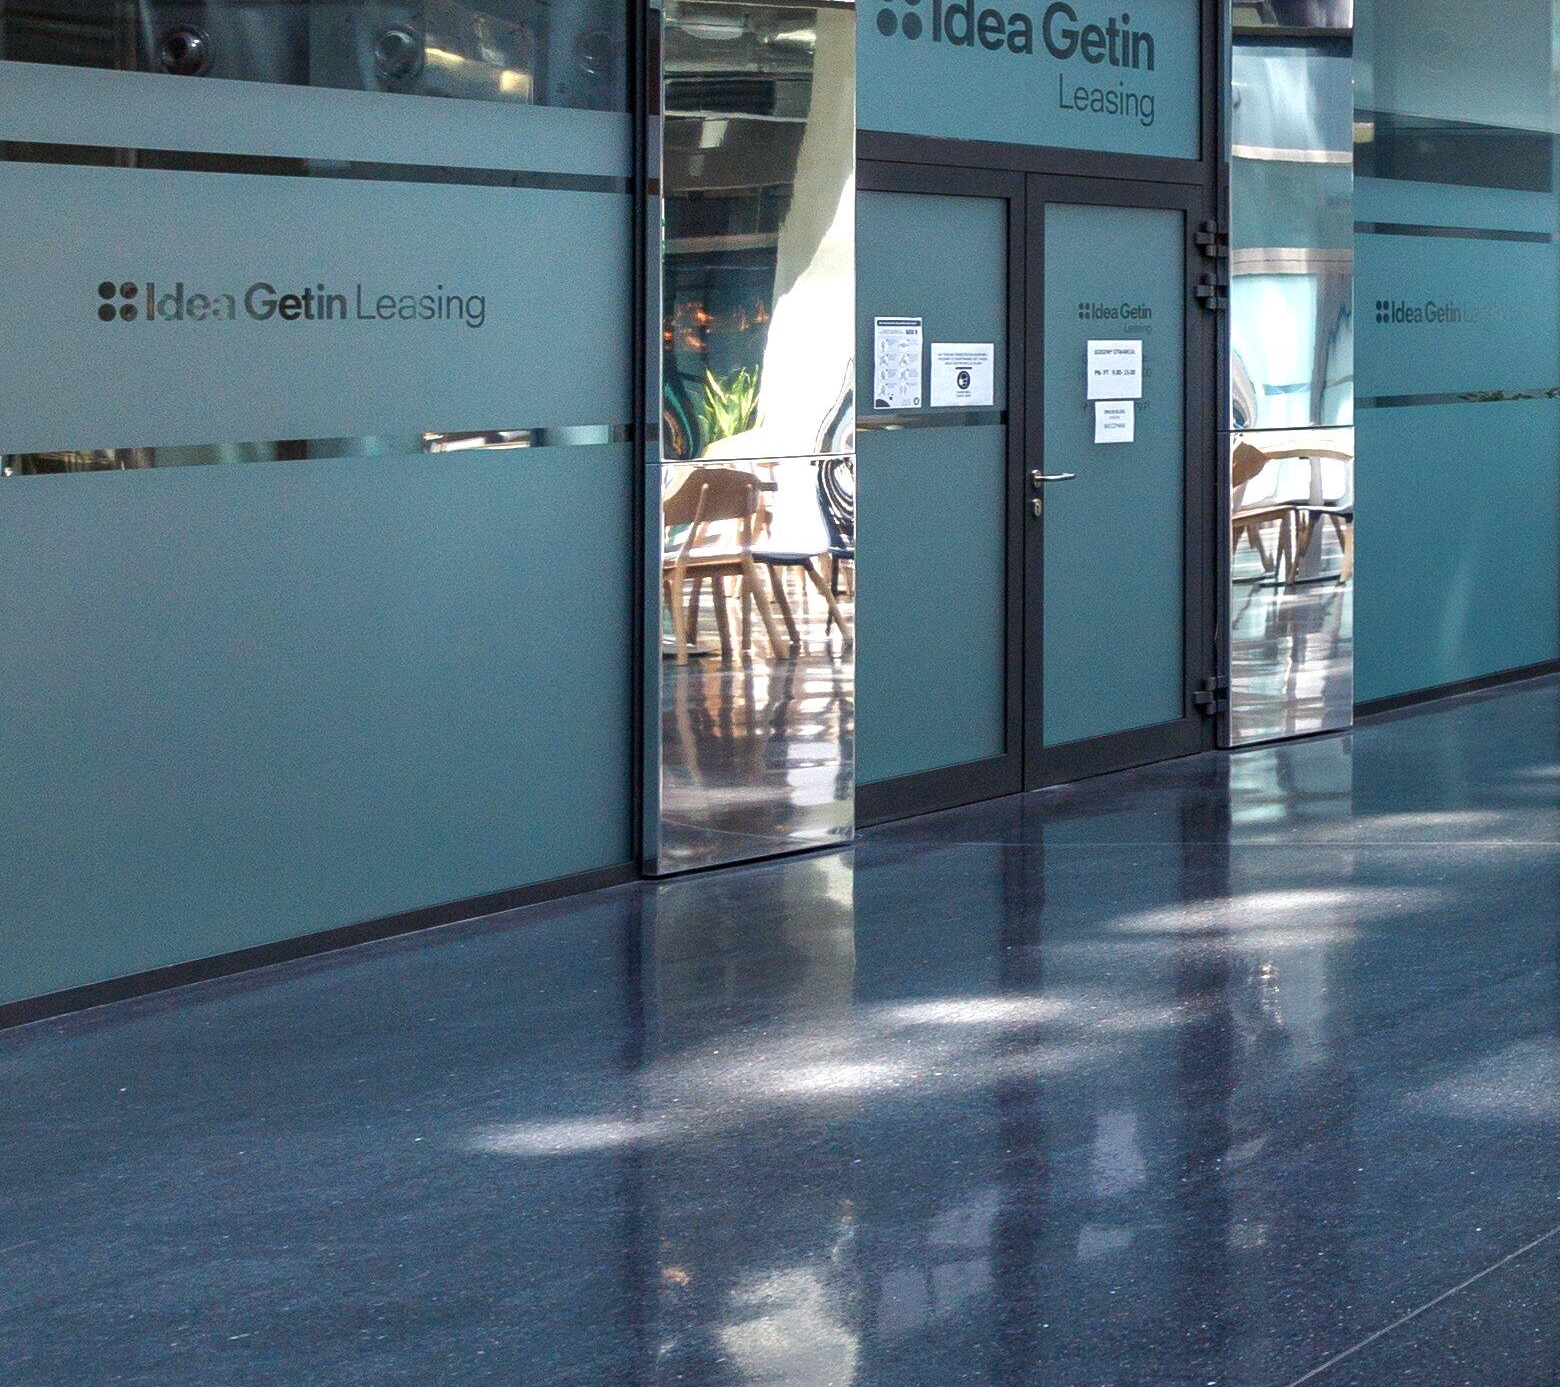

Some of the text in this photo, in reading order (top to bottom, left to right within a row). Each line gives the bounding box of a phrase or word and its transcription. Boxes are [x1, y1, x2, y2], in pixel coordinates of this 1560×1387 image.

[1042, 1, 1155, 72] Getin
[1058, 73, 1156, 127] Leasing
[146, 281, 486, 328] Idea Getin Leasing
[1091, 302, 1153, 320] Idea Getin
[1391, 300, 1423, 323] Idea
[1424, 300, 1462, 323] Getin
